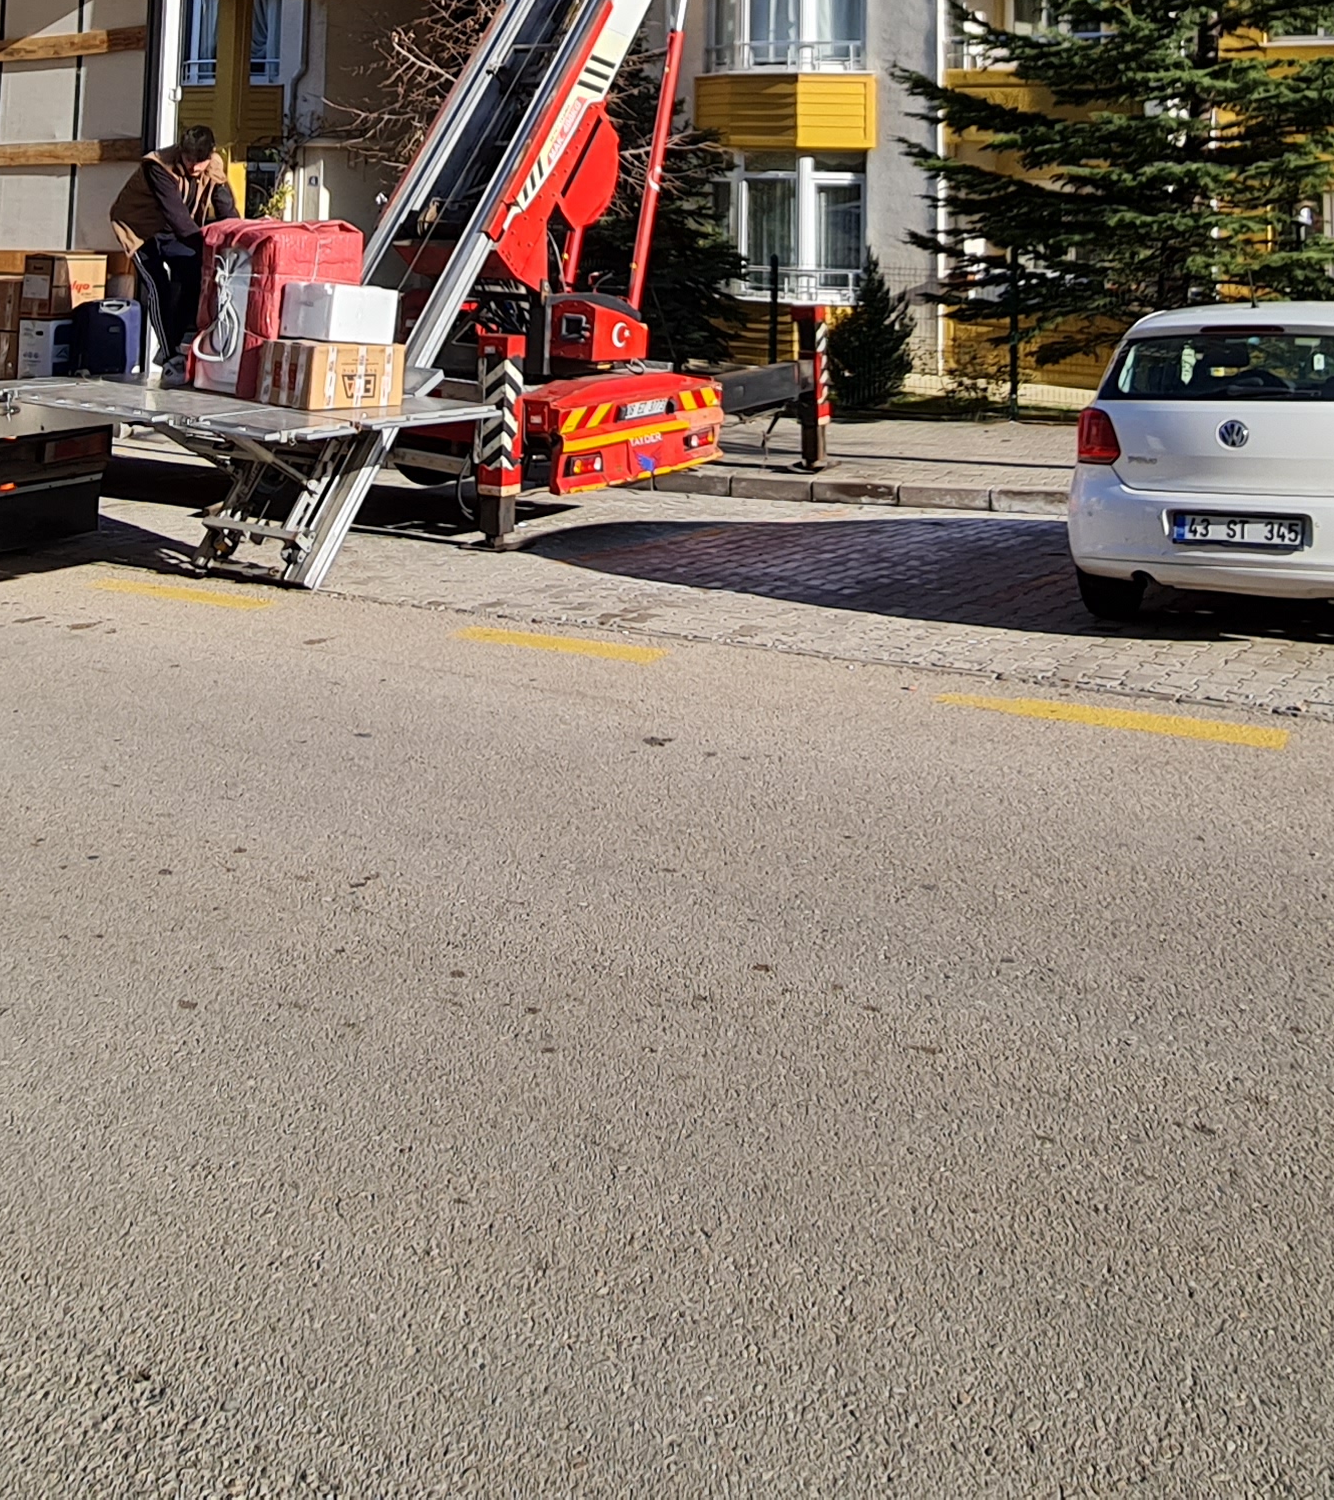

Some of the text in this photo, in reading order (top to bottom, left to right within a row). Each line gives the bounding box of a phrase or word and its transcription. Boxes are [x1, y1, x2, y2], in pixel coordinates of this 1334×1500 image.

[1188, 517, 1210, 538] 43
[1226, 519, 1249, 540] ST
[1264, 521, 1300, 543] 345
